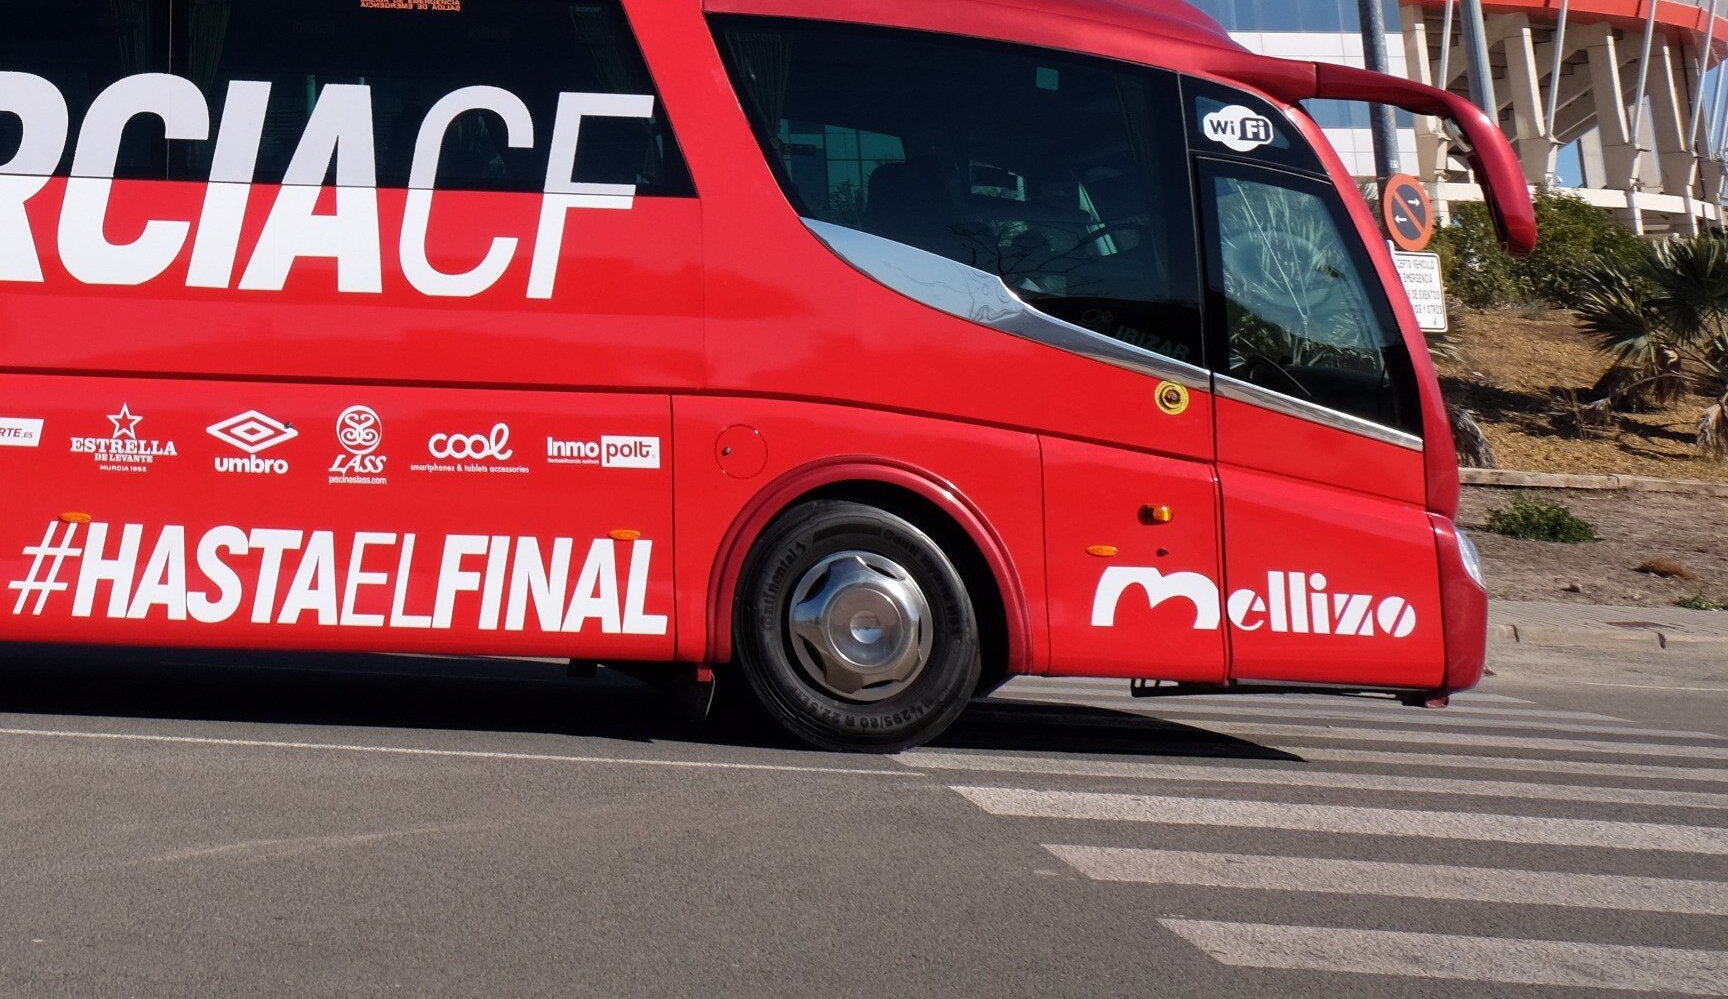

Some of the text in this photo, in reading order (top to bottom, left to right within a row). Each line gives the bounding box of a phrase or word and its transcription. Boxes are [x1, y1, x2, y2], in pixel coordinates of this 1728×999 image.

[70, 437, 178, 456] ESTRELLA
[428, 423, 513, 461] cool
[95, 453, 154, 463] DE LEVANTE
[215, 455, 289, 475] umbro
[328, 453, 387, 476] LASS
[410, 463, 455, 473] smartphones
